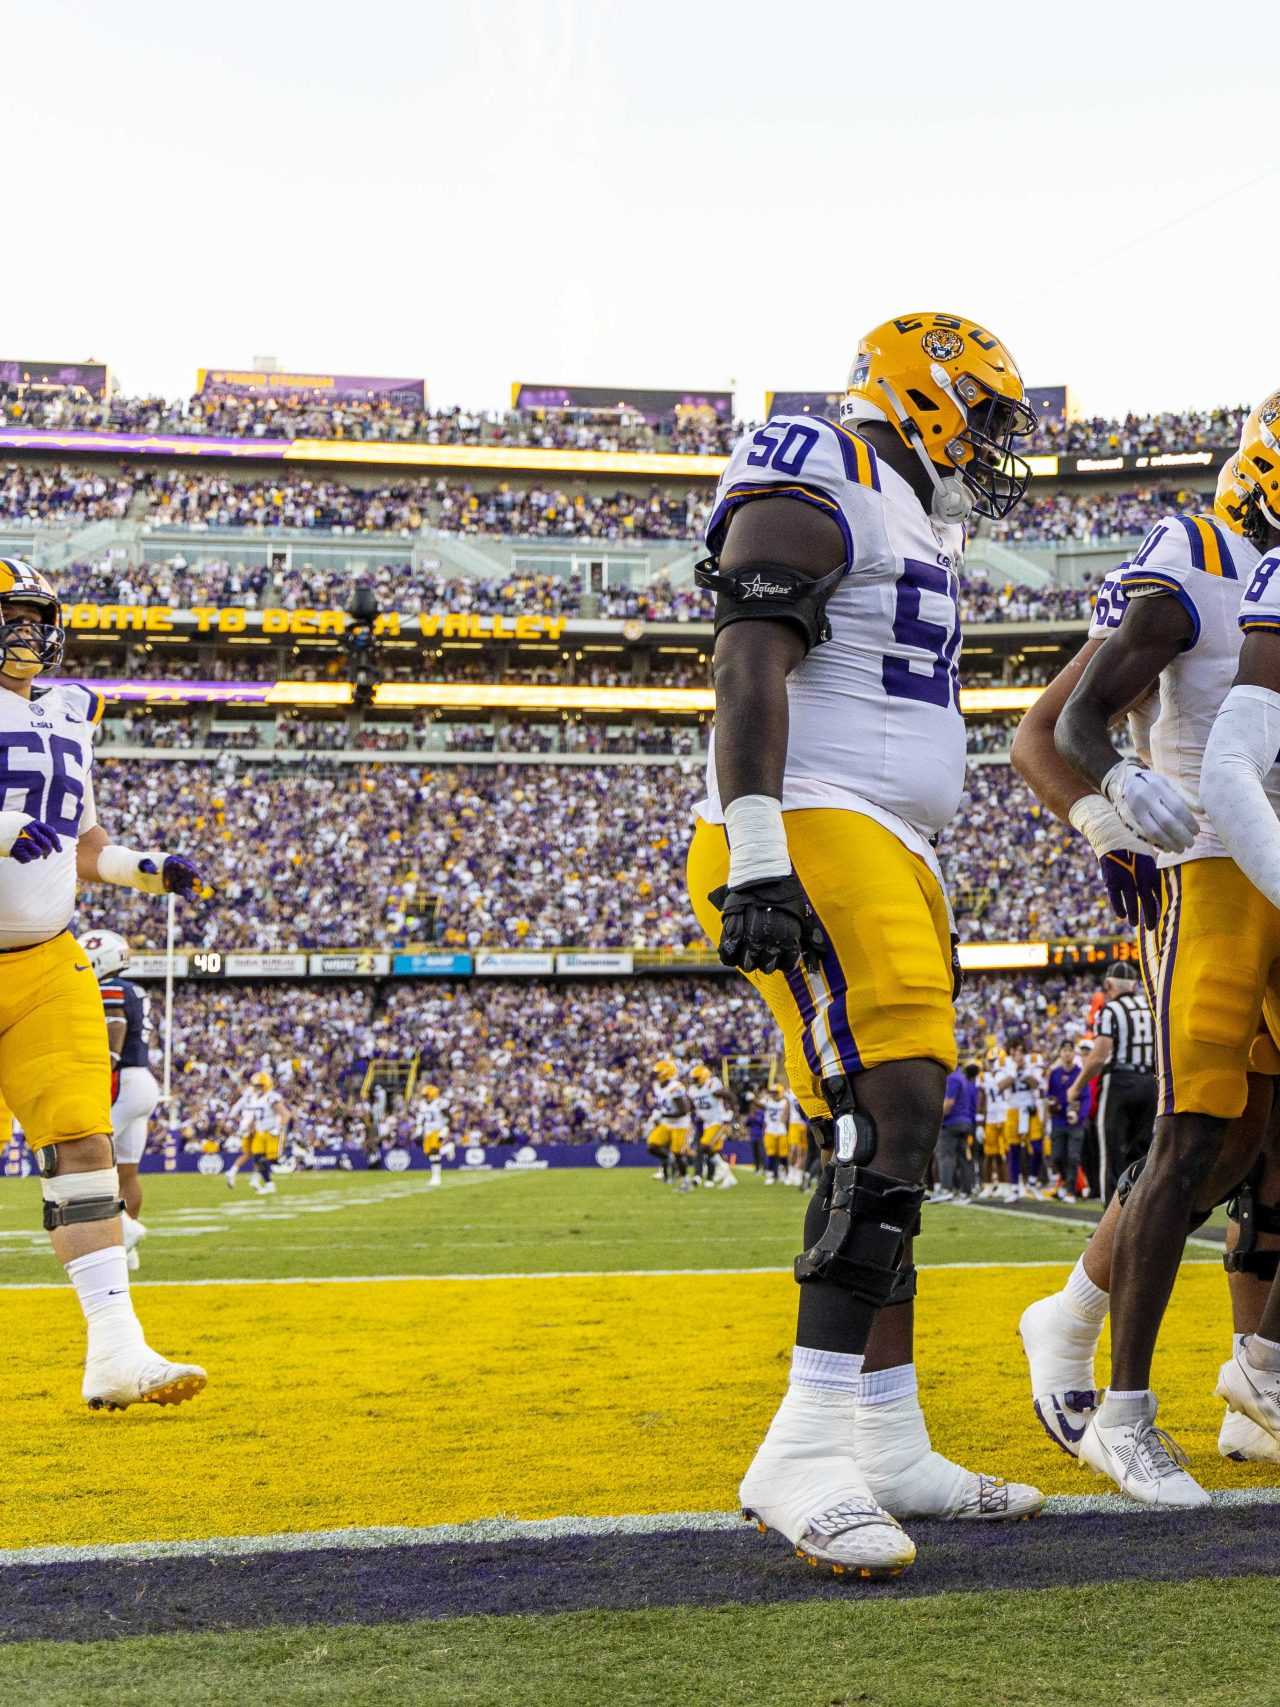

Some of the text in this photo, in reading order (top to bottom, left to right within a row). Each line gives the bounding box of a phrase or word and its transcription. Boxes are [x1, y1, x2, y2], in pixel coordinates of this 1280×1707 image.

[746, 421, 820, 477] 50
[751, 582, 793, 596] Douglas
[191, 607, 246, 632] TO
[418, 612, 568, 640] VALLEY
[193, 952, 221, 973] 40
